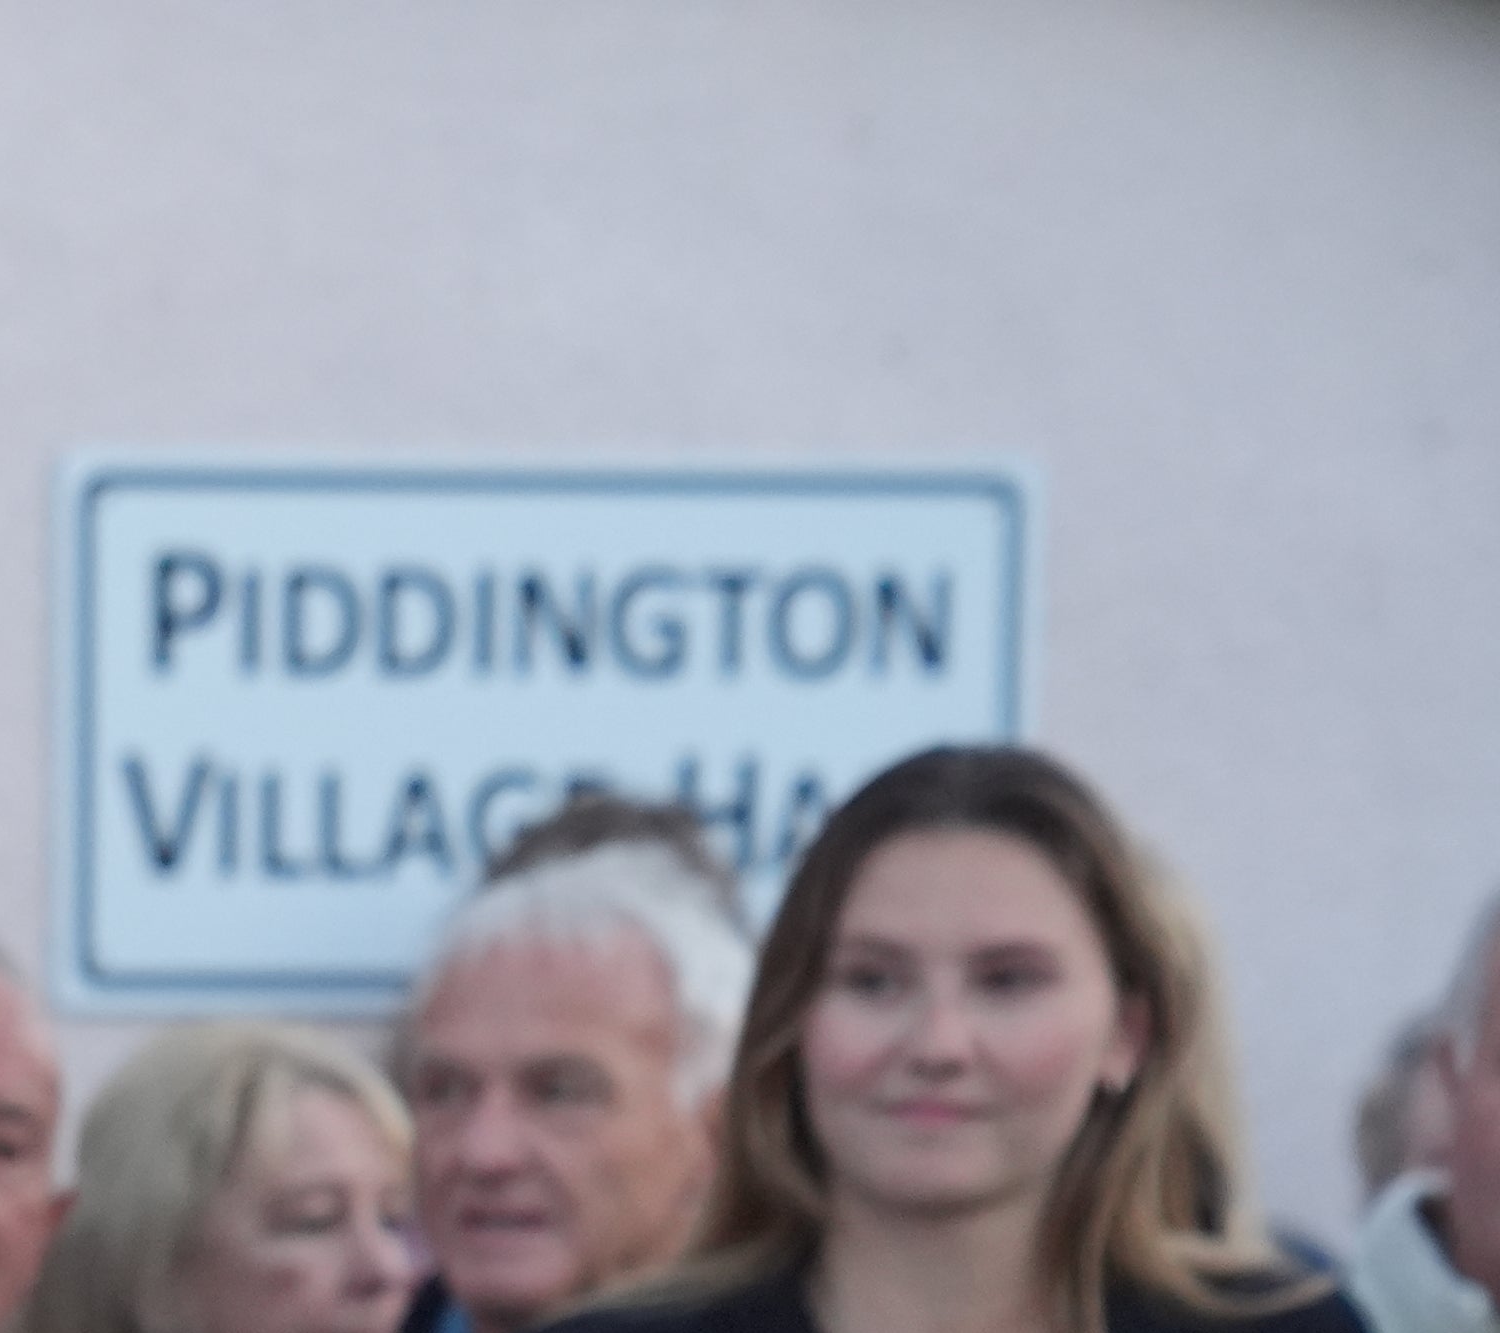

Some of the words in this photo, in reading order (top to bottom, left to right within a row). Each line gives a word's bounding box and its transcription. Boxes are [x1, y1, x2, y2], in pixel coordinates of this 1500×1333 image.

[146, 548, 956, 682] PIDDINGTON
[120, 752, 618, 882] VILLAG
[672, 752, 836, 874] HA
